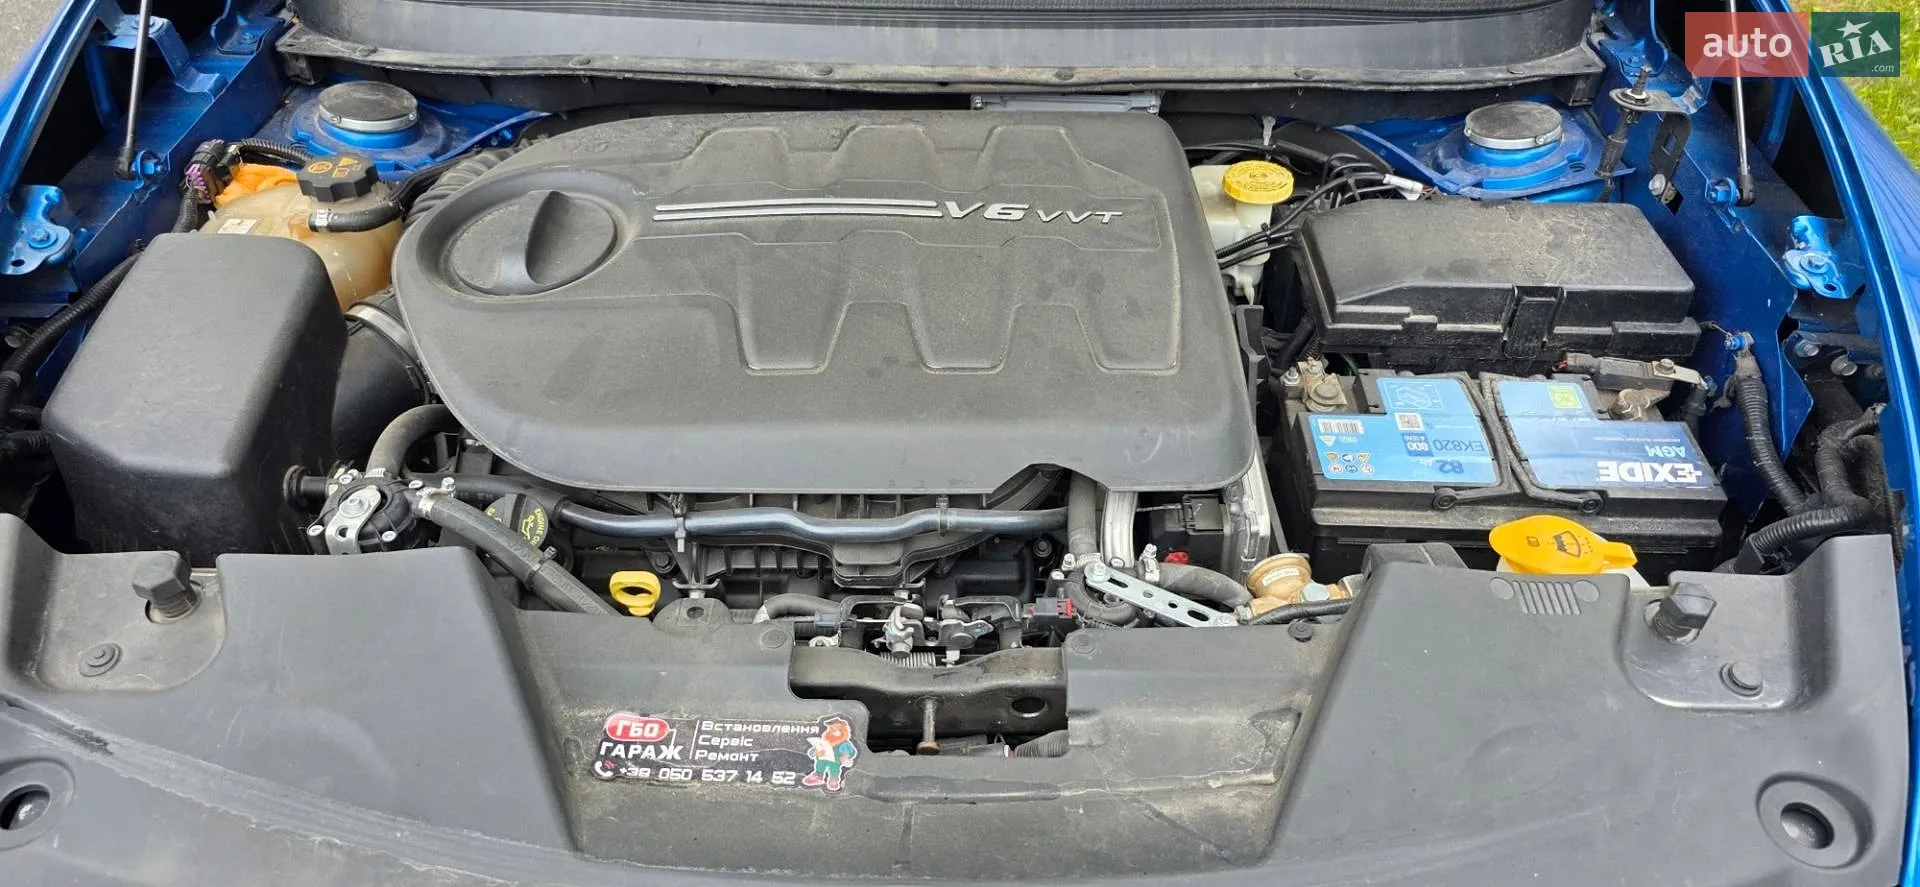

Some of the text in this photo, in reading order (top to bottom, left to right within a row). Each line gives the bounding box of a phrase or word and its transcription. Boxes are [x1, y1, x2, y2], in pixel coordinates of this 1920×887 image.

[944, 201, 1123, 224] V6 VVT
[1433, 439, 1486, 452] EK820
[1644, 444, 1686, 458] AGM
[1436, 460, 1464, 474] 82
[1596, 460, 1703, 483] EXIDE
[615, 719, 661, 739] ГБО
[701, 720, 820, 735] Встановлення
[698, 734, 754, 748] Сервіс
[600, 741, 684, 761] ГАРАЖ
[694, 749, 759, 763] Ремонт
[619, 766, 796, 785] +38 050 537 14 52
